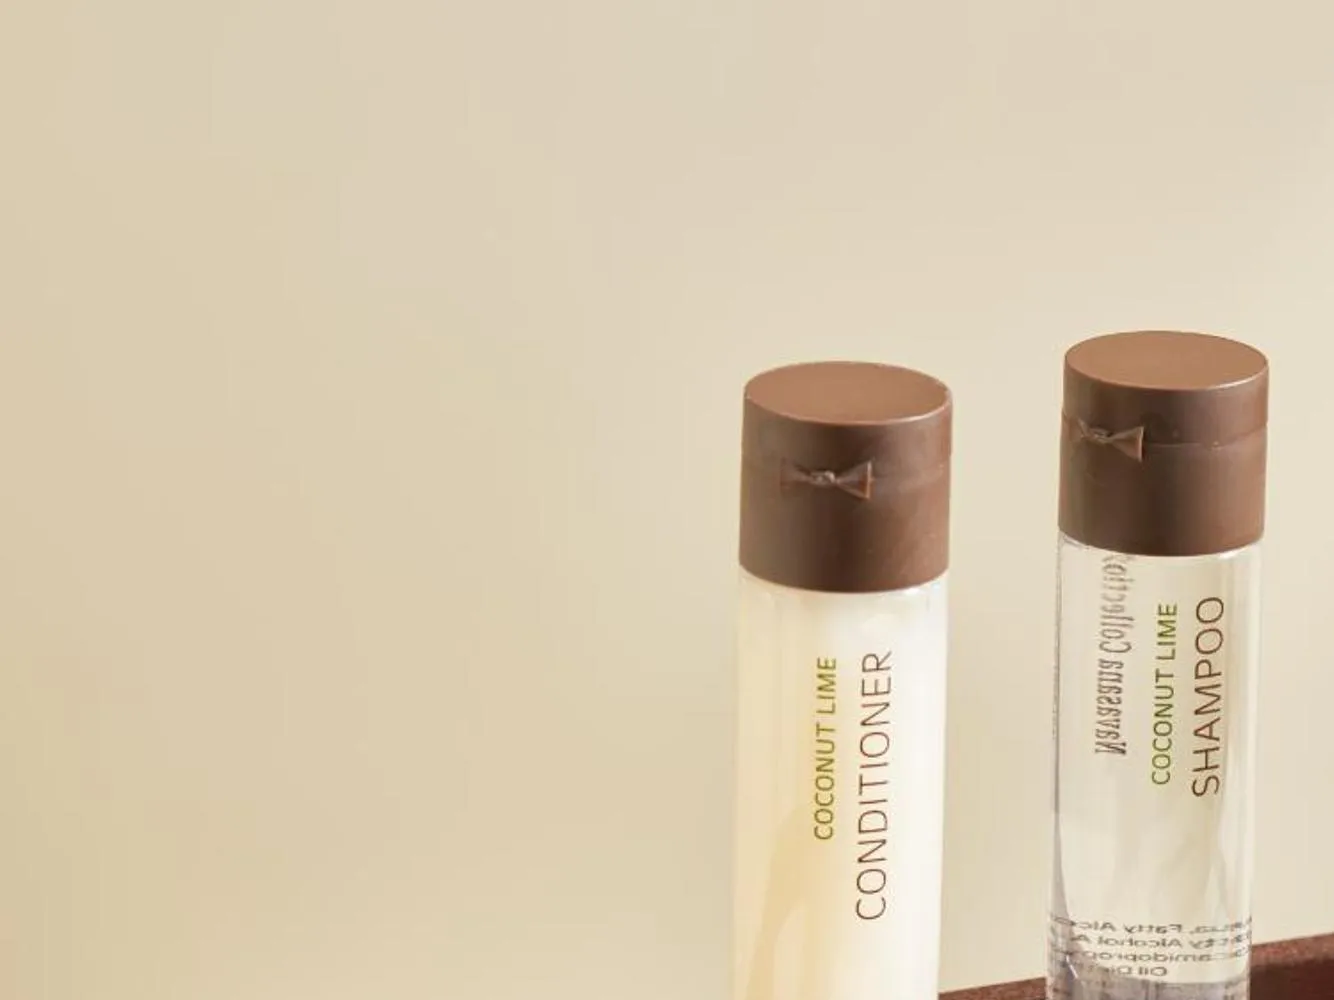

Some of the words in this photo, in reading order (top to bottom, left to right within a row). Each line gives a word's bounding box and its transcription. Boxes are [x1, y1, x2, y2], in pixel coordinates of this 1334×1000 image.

[815, 656, 837, 715] LIME
[1156, 603, 1178, 661] LIME
[1151, 668, 1175, 786] COCONUT
[1190, 596, 1225, 798] SHAMPOO
[813, 722, 836, 841] COCONUT
[854, 650, 892, 921] CONDITIONER
